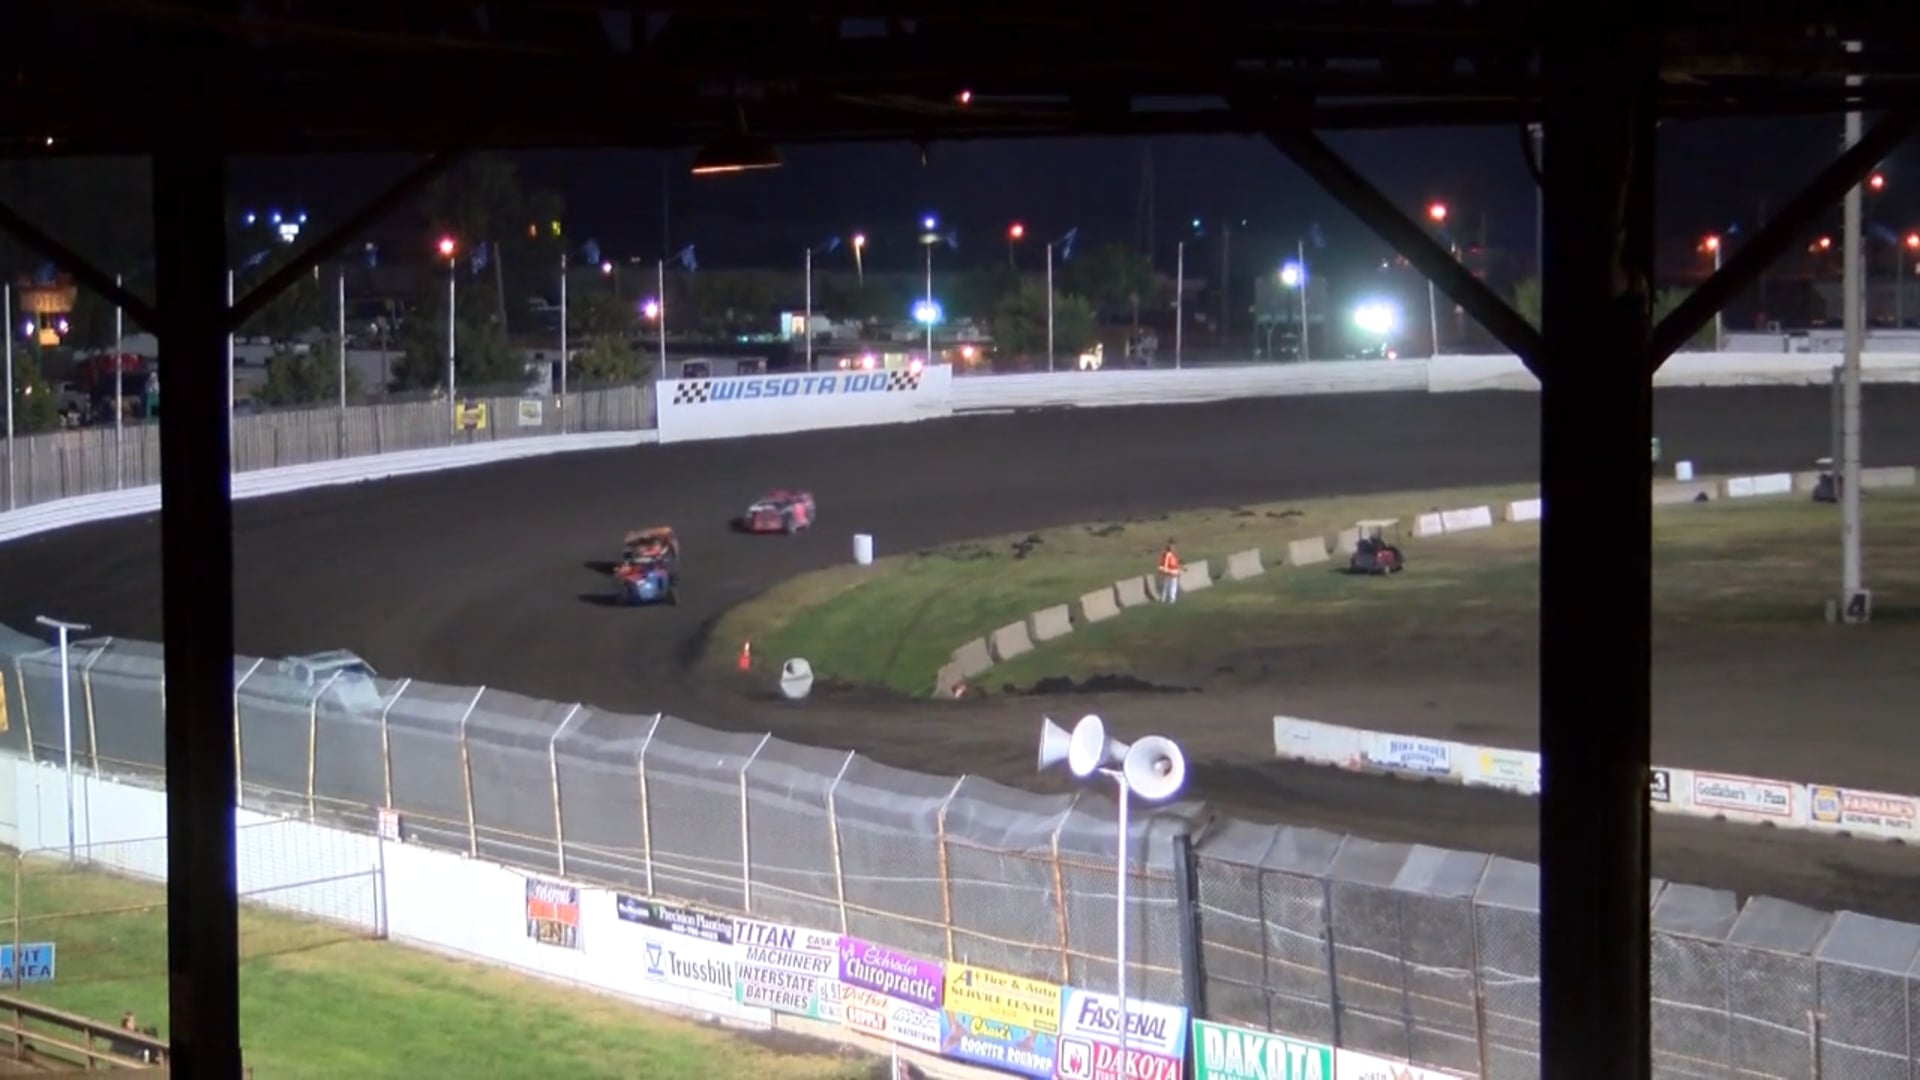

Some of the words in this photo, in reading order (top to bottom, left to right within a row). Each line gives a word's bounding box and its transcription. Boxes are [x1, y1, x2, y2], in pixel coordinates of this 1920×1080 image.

[709, 376, 835, 401] WISSOTA
[842, 373, 888, 393] 100
[736, 921, 796, 949] TITAN
[806, 935, 833, 946] CASE
[668, 950, 734, 989] Trussbilt
[746, 947, 833, 973] MACHINERY
[739, 965, 816, 993] INTERSTATE
[846, 957, 938, 1003] Chiropractic
[1026, 982, 1058, 999] Auto
[745, 985, 809, 1009] BATTERIES
[1077, 996, 1167, 1041] FASENAL
[1096, 1043, 1176, 1080] DAKOTA
[1204, 1026, 1322, 1080] DAKOTA
